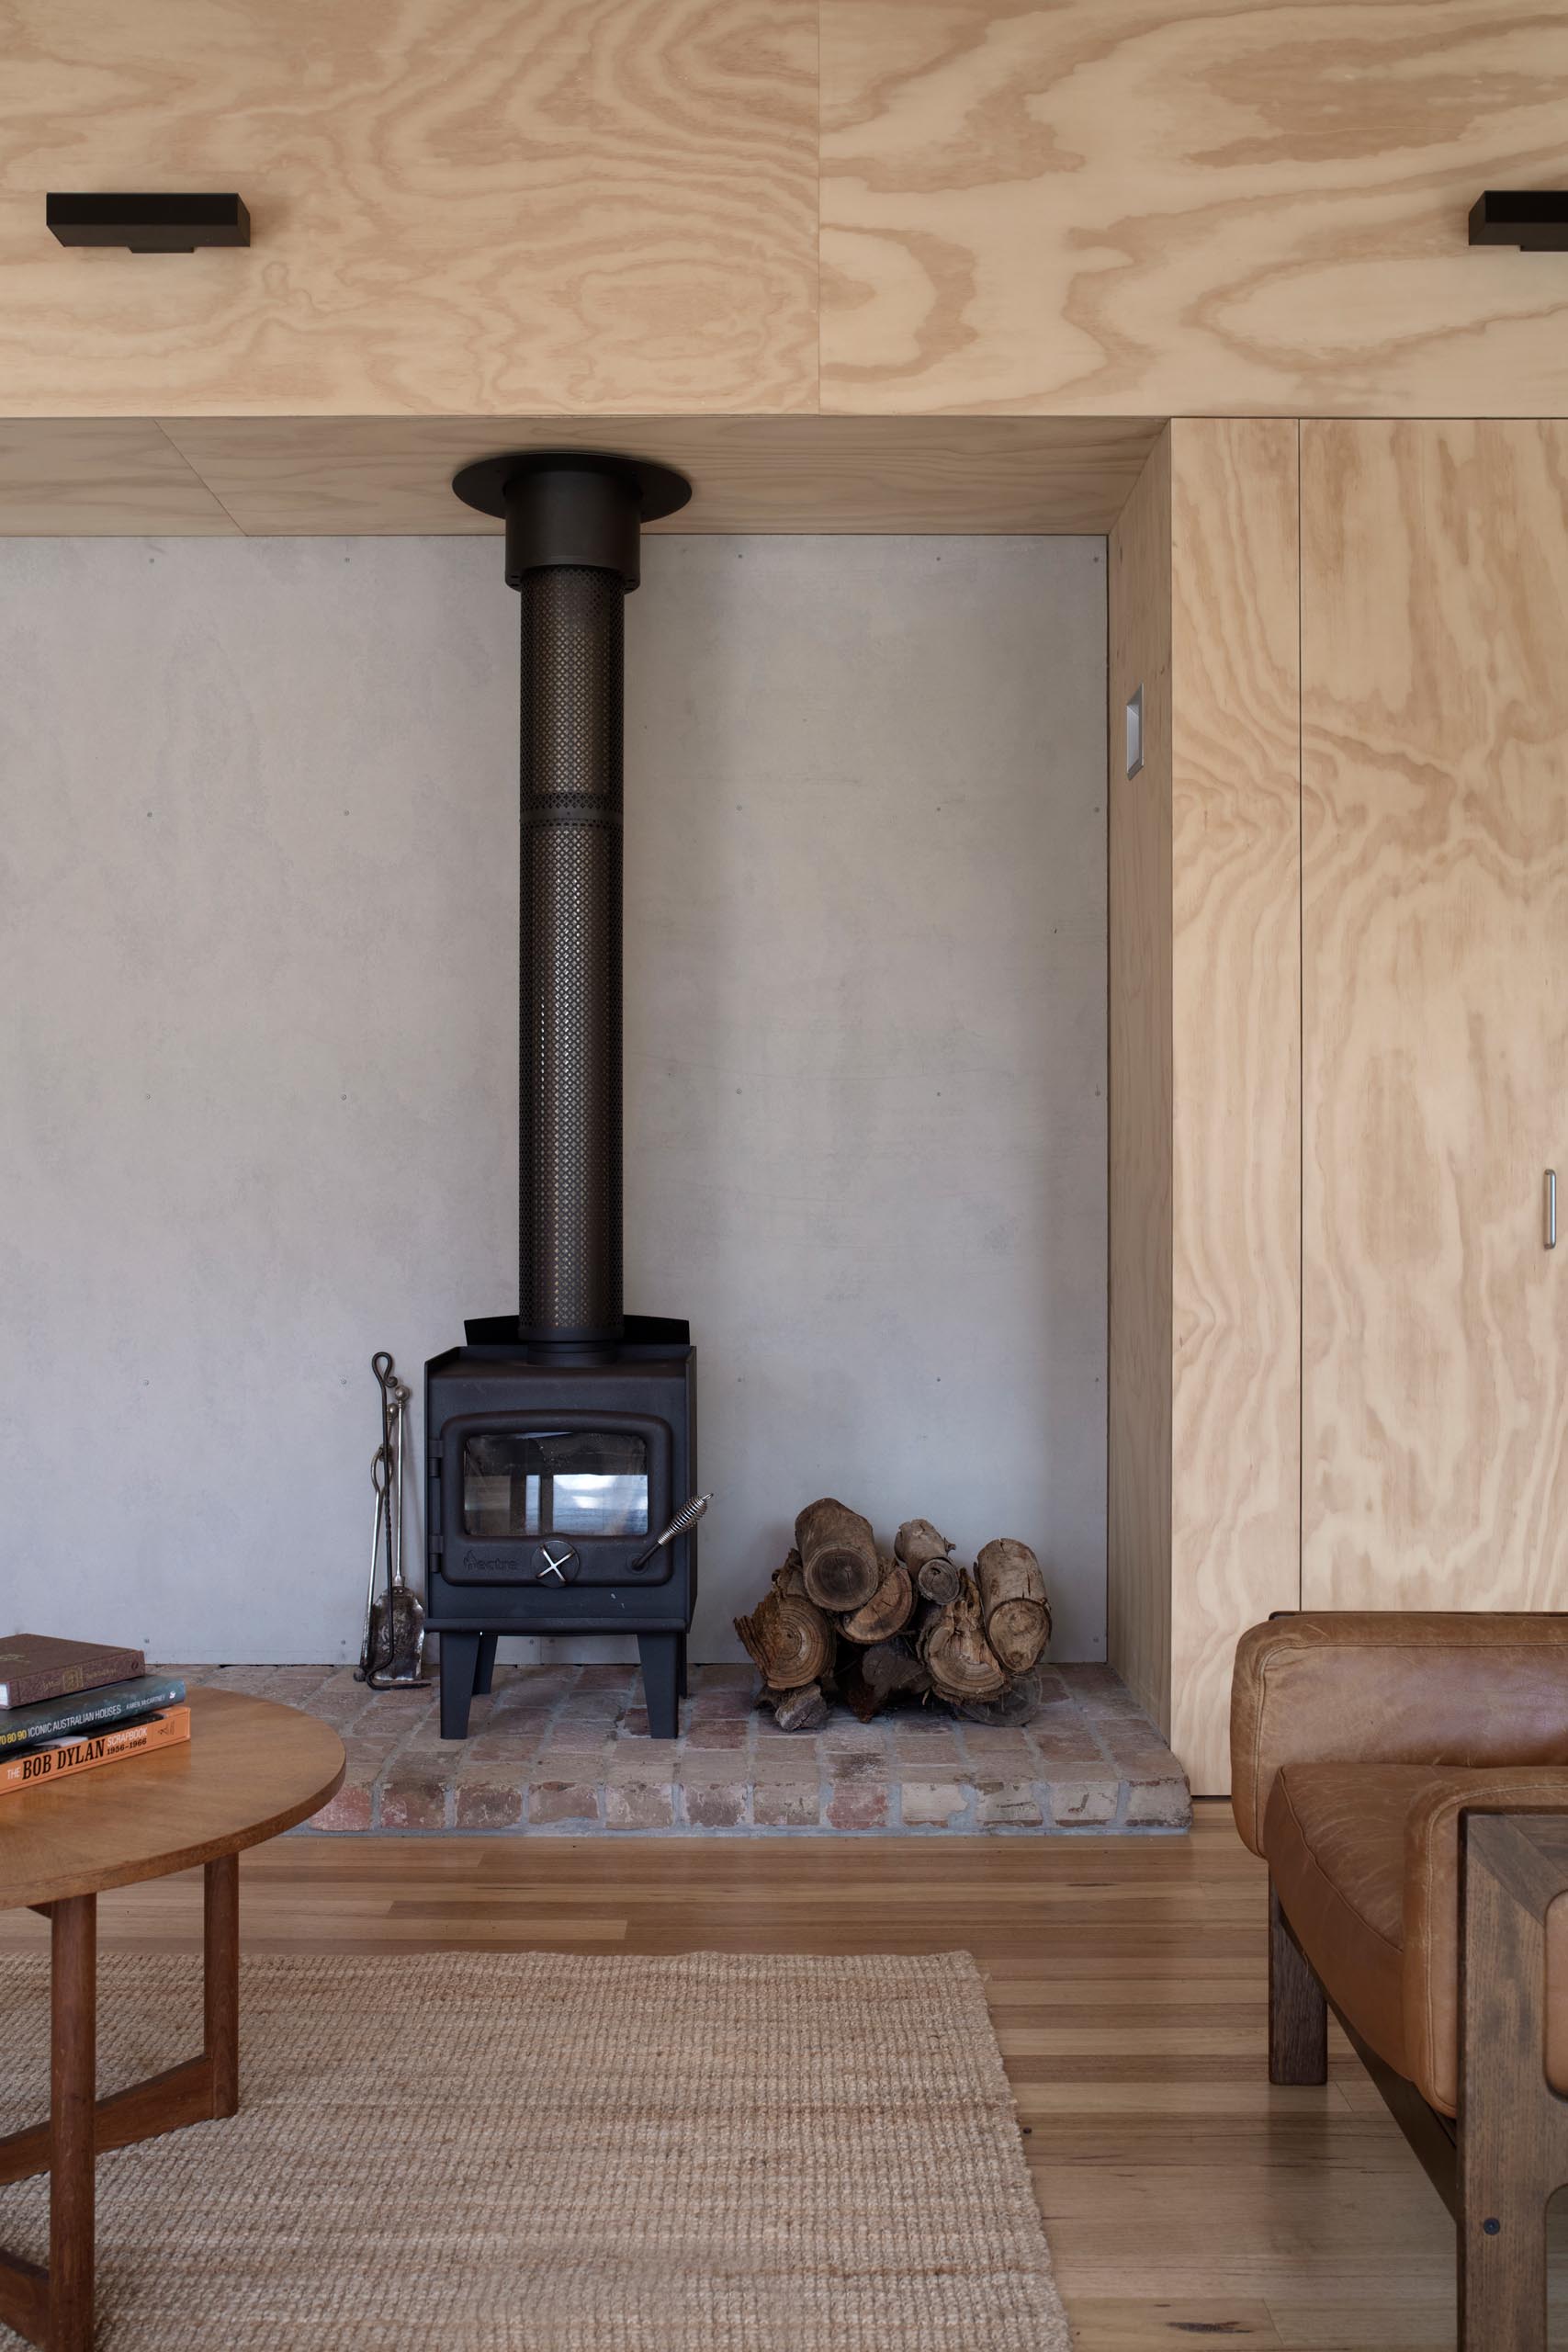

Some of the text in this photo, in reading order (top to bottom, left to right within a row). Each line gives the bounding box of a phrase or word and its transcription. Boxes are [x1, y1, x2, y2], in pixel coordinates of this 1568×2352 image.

[6, 1732, 17, 1744] 80
[17, 1729, 27, 1741] 90
[28, 1723, 52, 1737] ICONIC
[52, 1712, 95, 1732] AUSTRALIAN
[95, 1704, 122, 1720] HOUSES
[6, 1766, 20, 1780] THE
[22, 1754, 51, 1781] BOB
[57, 1738, 106, 1770] DYLAN
[107, 1727, 148, 1747] SCRAPBOOK
